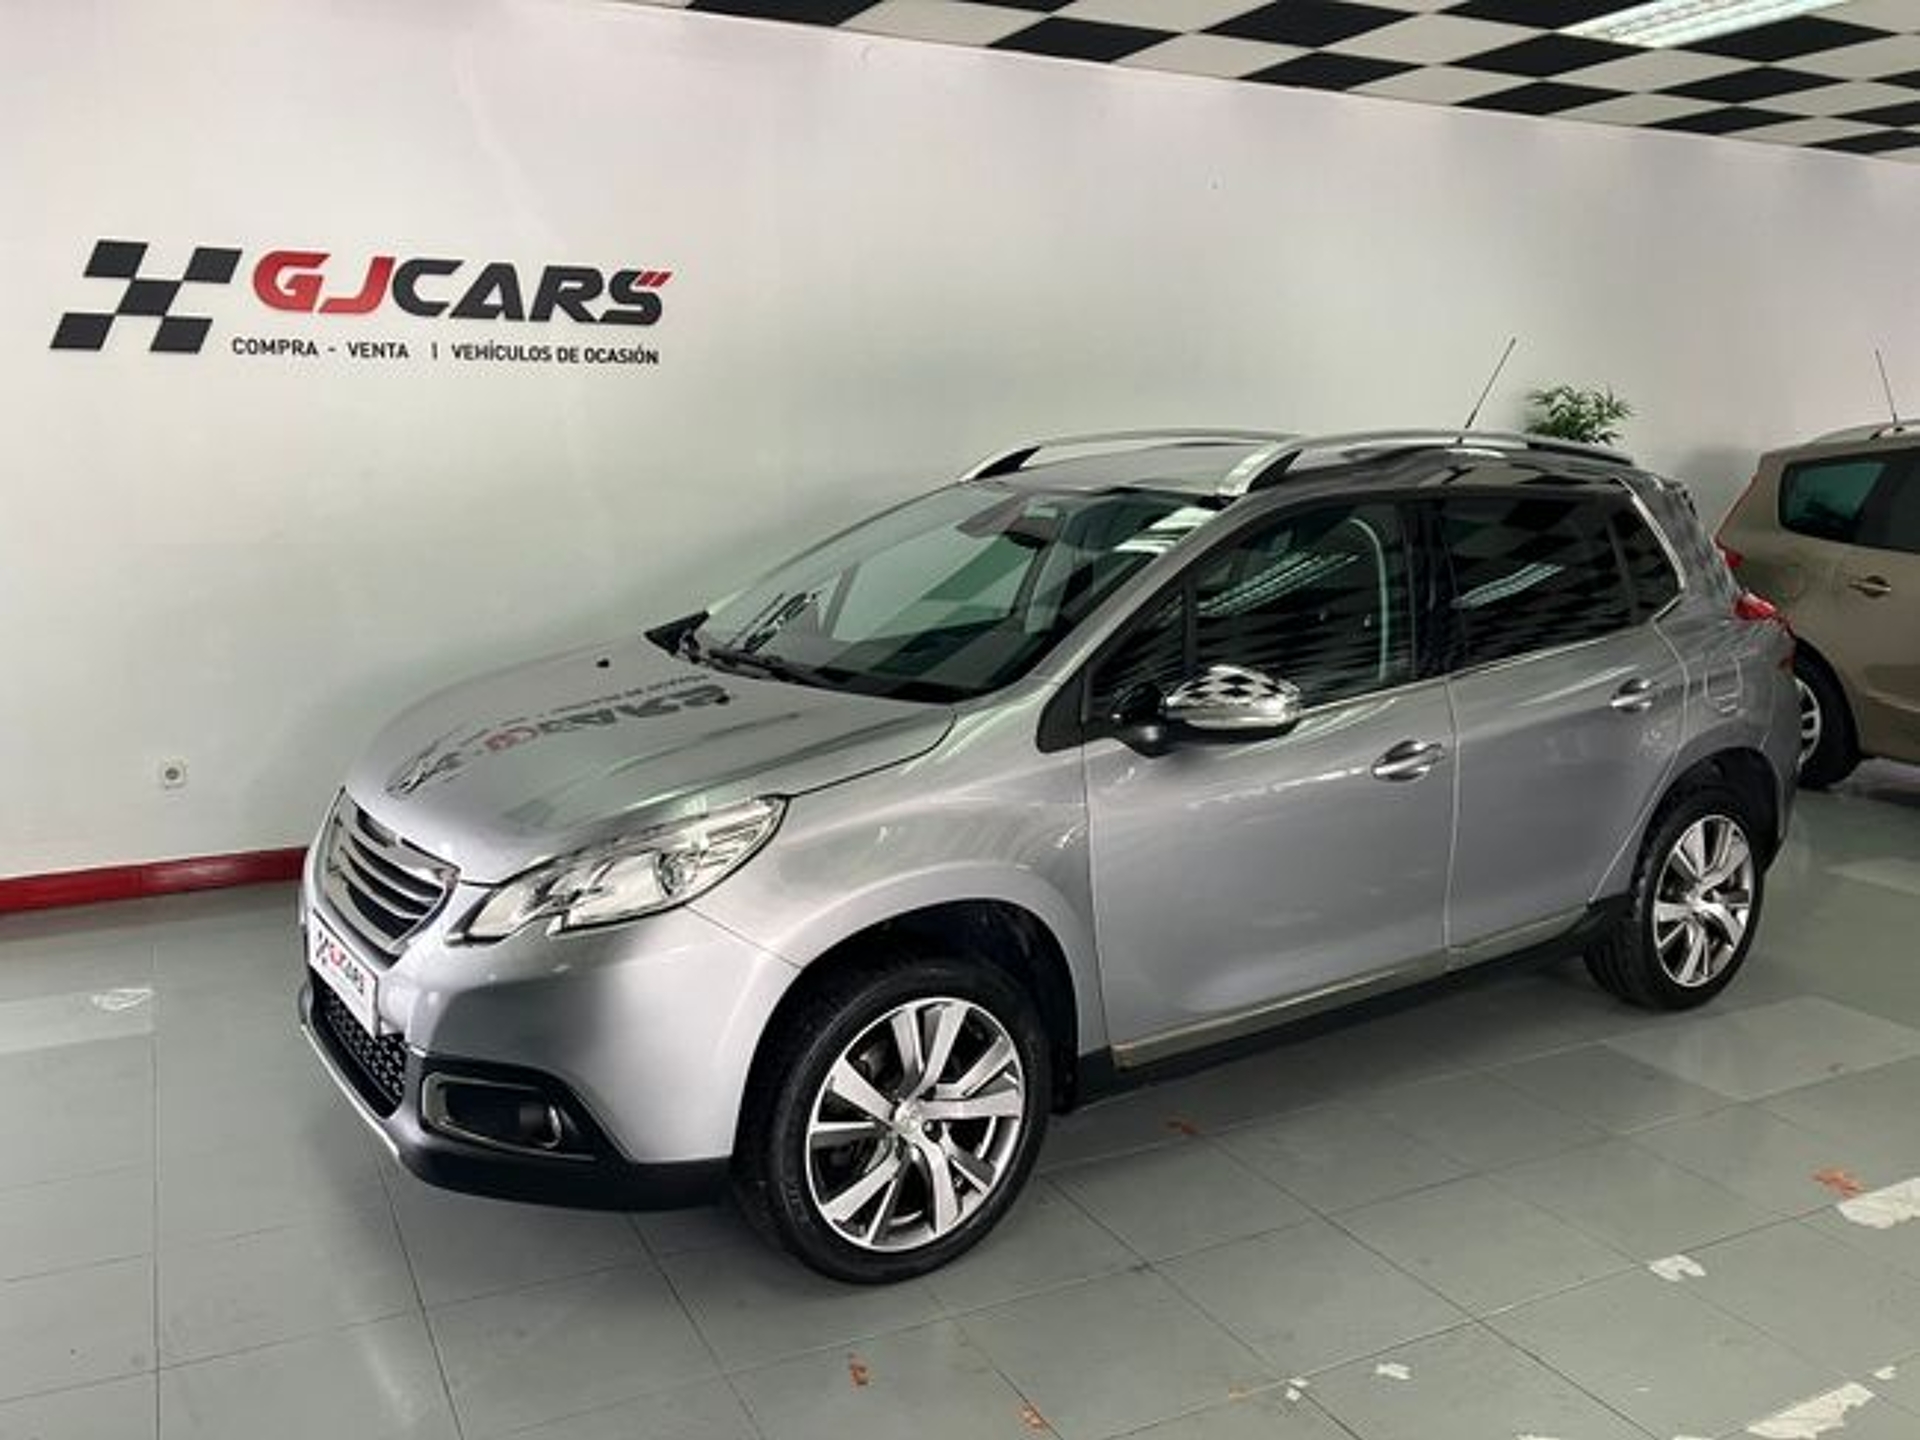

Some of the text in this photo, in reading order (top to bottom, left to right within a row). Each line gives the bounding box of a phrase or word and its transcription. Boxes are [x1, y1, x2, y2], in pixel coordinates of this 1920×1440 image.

[252, 250, 672, 326] GJCARS
[232, 337, 319, 356] COMPRA
[347, 342, 410, 359] VENTA
[451, 339, 553, 362] VEHÍCULOS
[556, 347, 580, 364] DE
[584, 344, 660, 366] OCASIÓN
